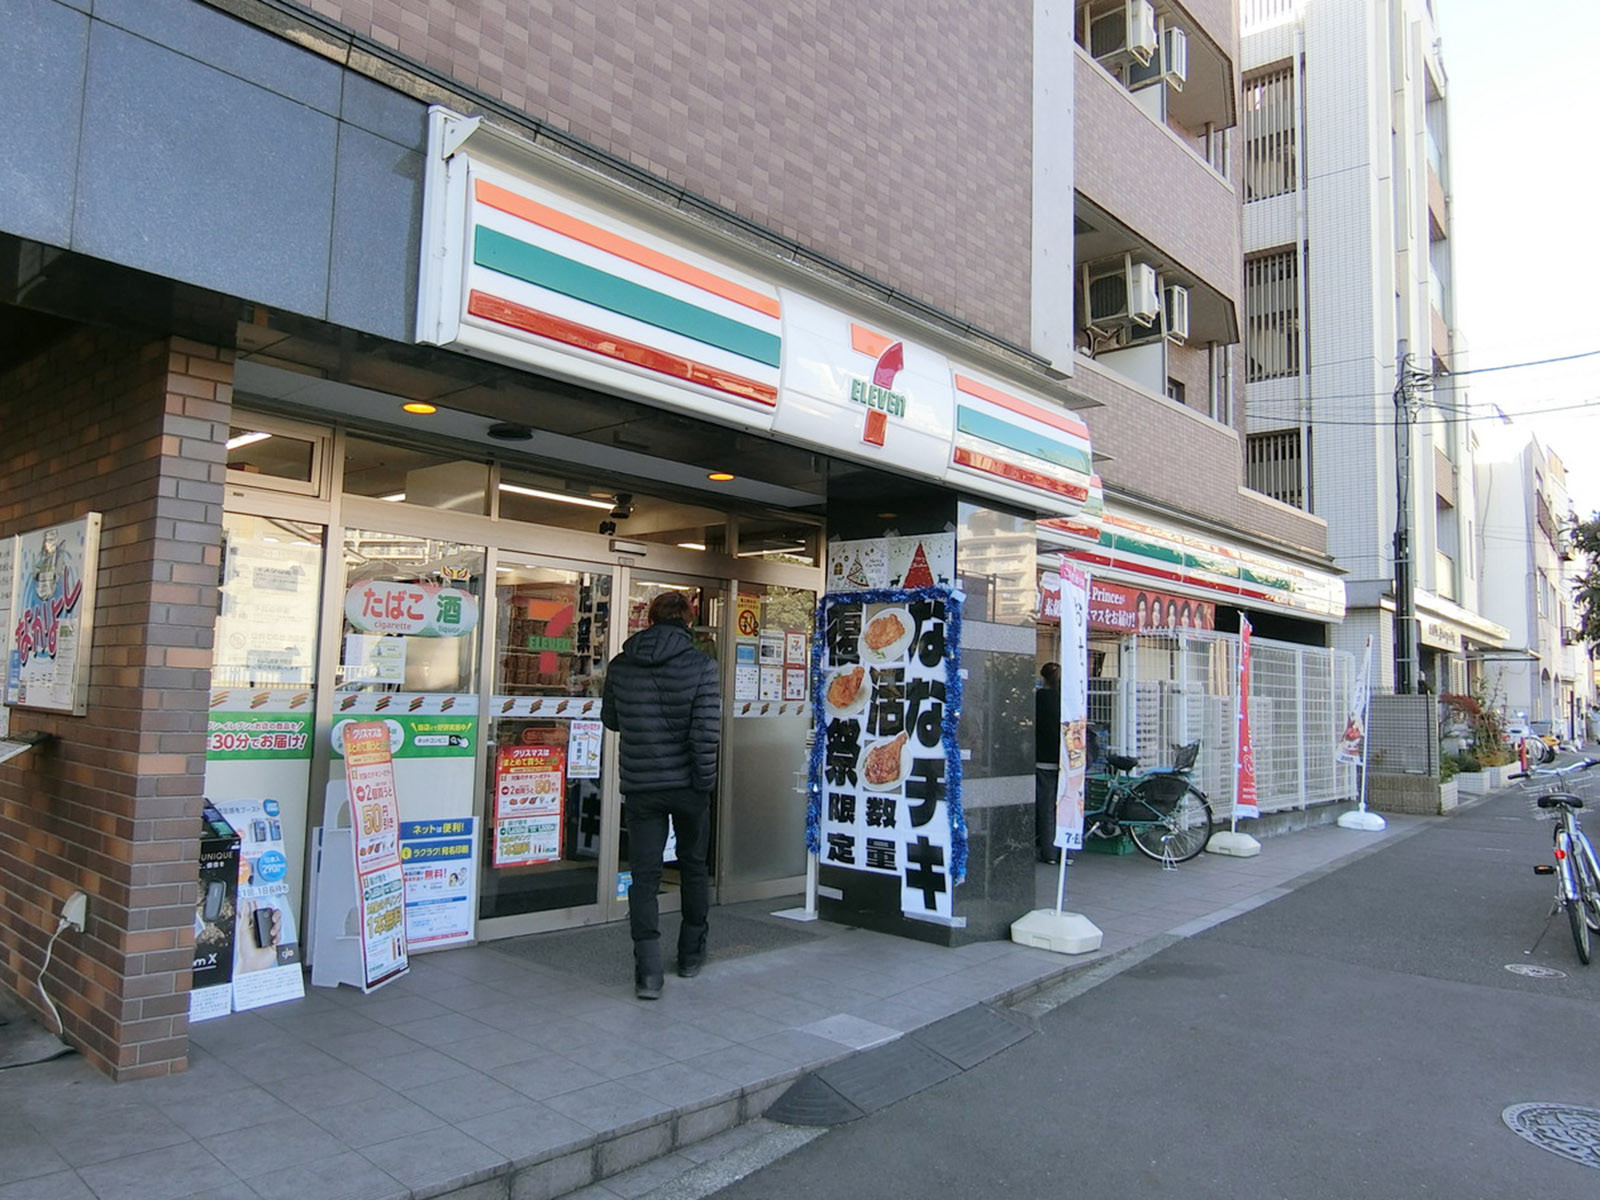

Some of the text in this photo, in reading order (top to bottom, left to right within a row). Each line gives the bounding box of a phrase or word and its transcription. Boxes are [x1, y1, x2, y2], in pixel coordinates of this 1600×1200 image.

[363, 588, 462, 624] たばこ 酒
[374, 621, 412, 631] cigarette
[903, 600, 948, 911] ななチキ
[362, 803, 383, 835] 50
[413, 822, 464, 834] ネットは便利!
[826, 793, 856, 865] 限定
[865, 796, 898, 868] 数量
